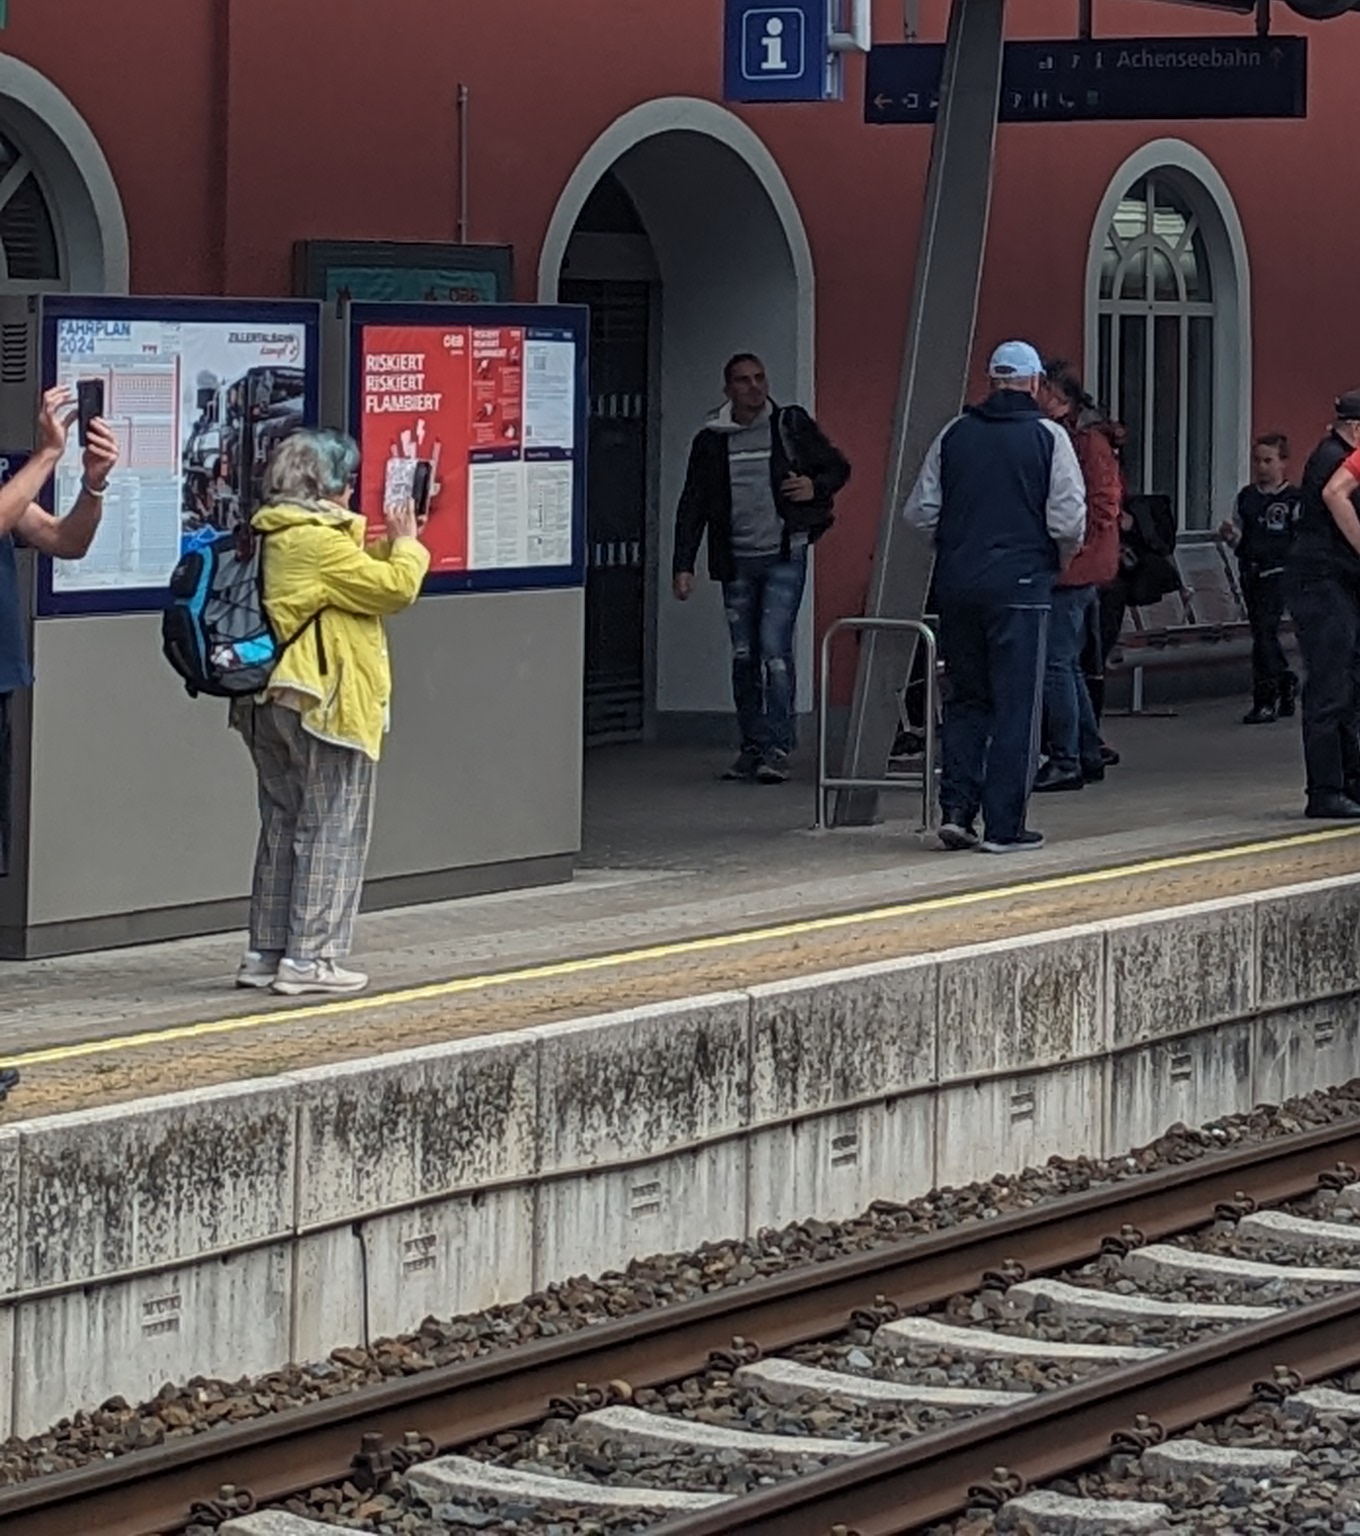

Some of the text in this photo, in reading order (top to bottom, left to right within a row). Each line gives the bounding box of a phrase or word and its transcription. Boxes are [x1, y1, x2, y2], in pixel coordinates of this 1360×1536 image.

[1117, 47, 1261, 68] Achenseebahn
[60, 321, 131, 337] FAHRPLAN
[60, 337, 95, 353] 2024
[366, 354, 425, 372] RISKIERT
[366, 374, 425, 392] RISKIERT
[366, 393, 442, 413] FLAMBIERT
